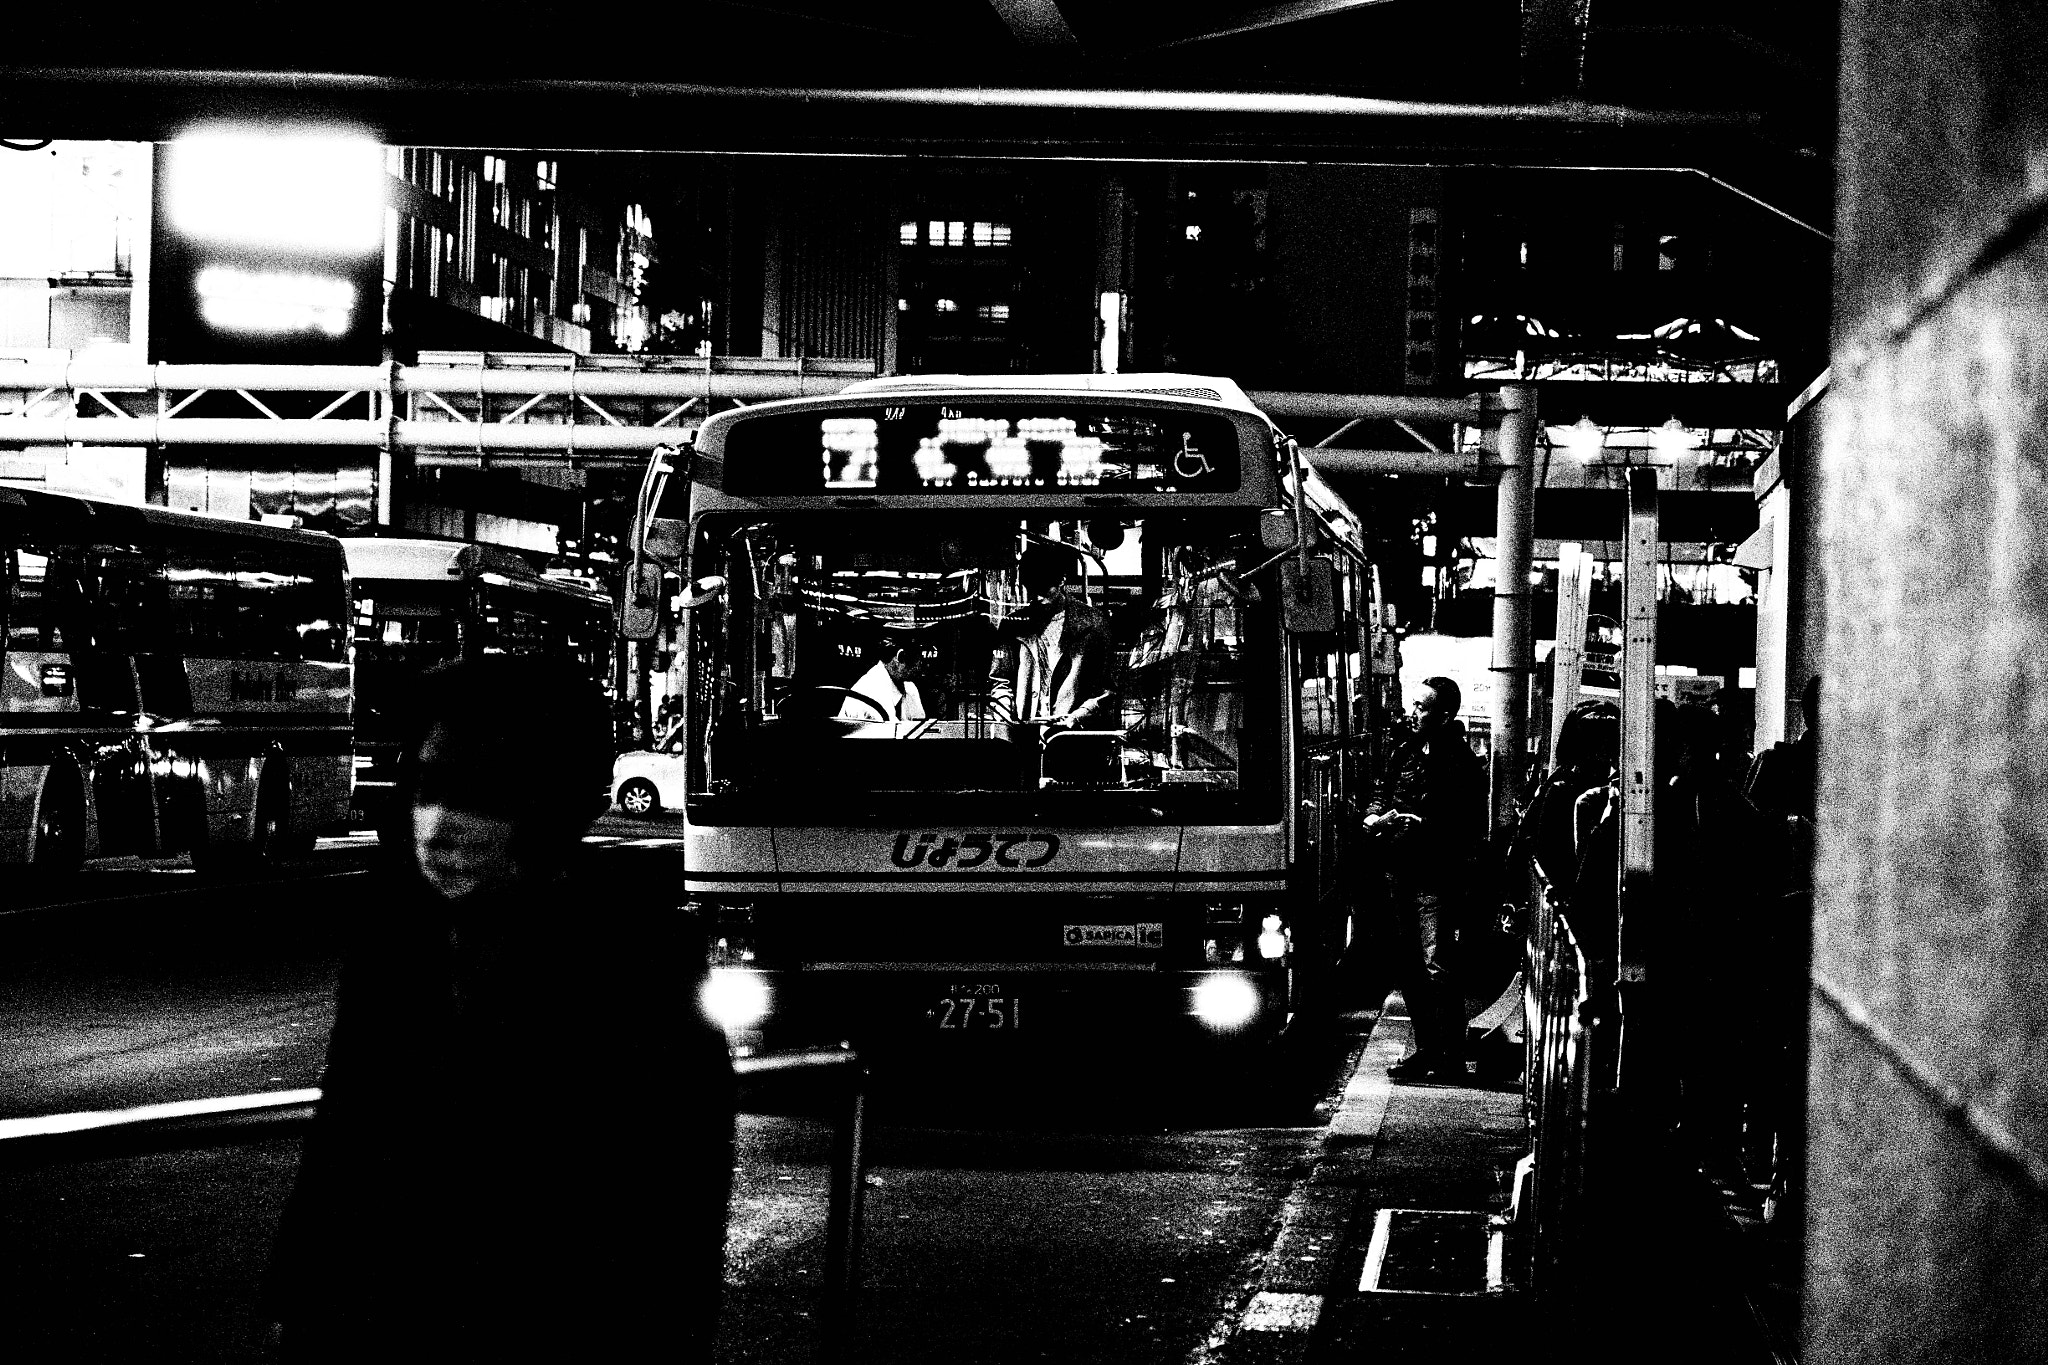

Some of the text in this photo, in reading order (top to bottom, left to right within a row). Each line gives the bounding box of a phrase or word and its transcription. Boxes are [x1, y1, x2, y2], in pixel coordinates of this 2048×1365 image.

[891, 834, 1061, 869] じょうてつ
[974, 984, 1000, 995] 200
[940, 999, 1019, 1029] 27-51
